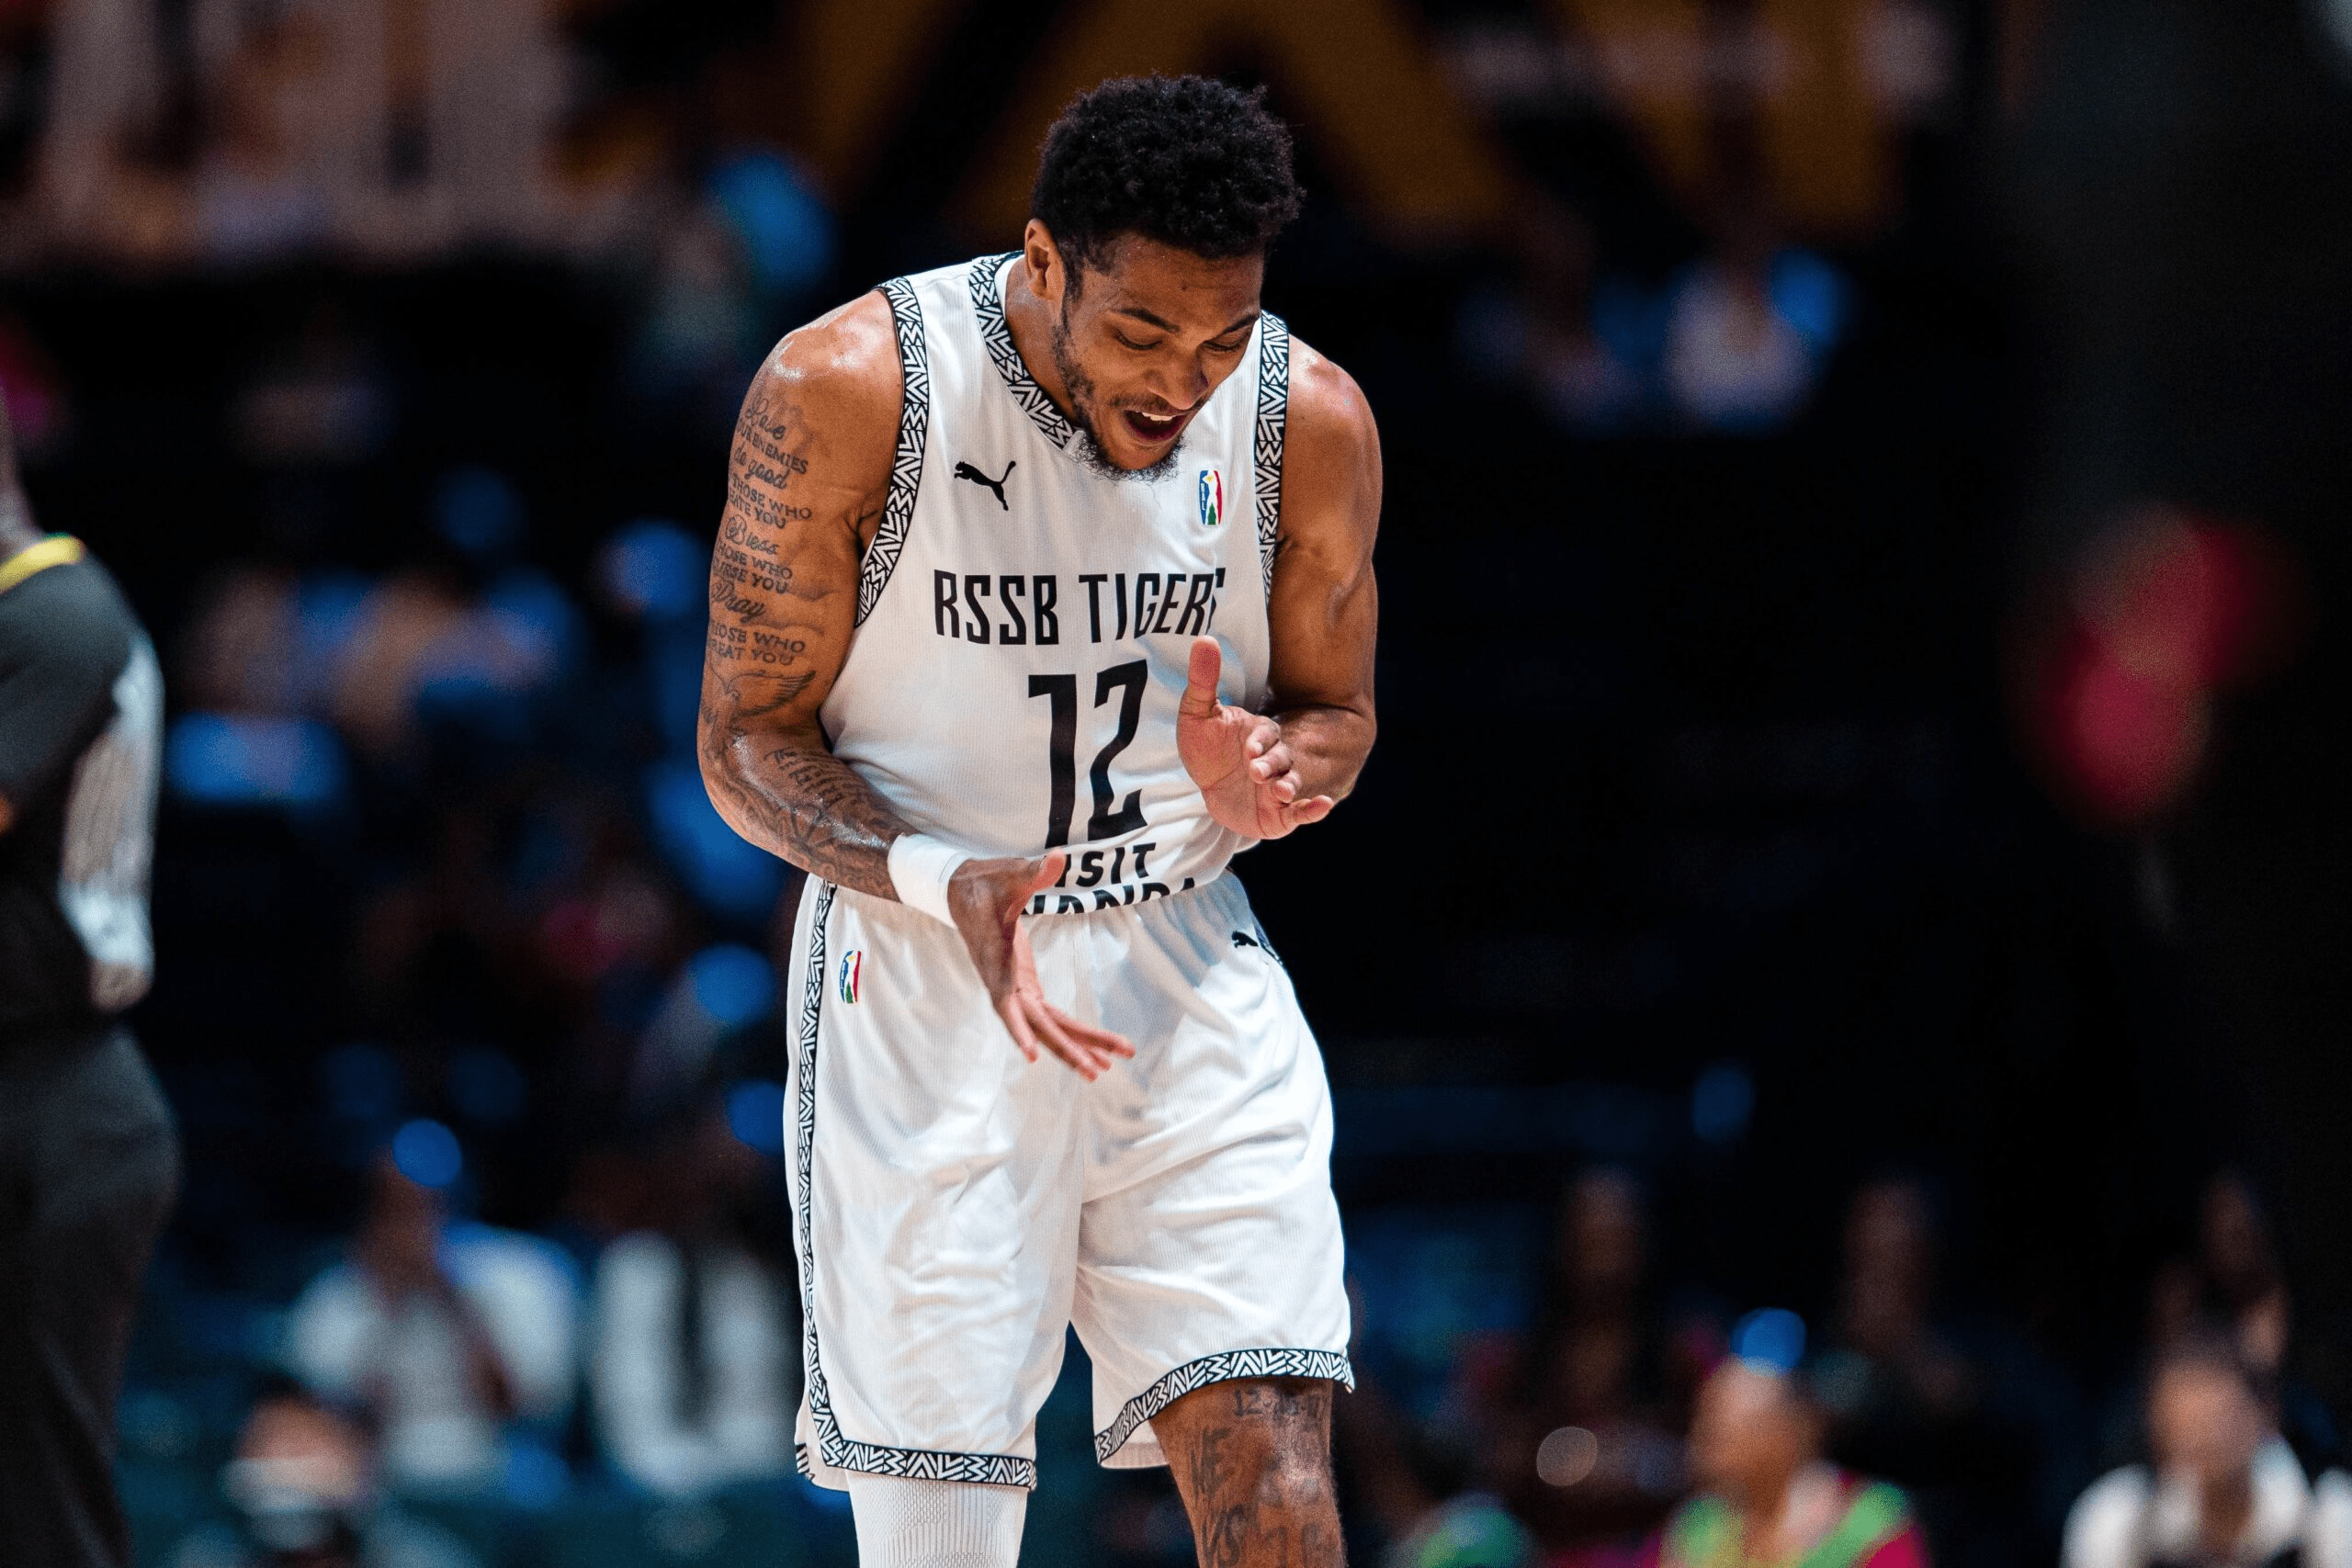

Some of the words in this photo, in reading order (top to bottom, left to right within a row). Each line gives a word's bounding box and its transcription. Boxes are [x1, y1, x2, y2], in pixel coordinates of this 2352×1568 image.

[752, 433, 808, 474] ENEMIES
[744, 460, 790, 490] good
[754, 506, 786, 529] YOU
[769, 498, 812, 519] WHO
[752, 556, 793, 580] WHO
[752, 572, 788, 594] YOU
[934, 569, 1059, 645] RSSB
[753, 631, 806, 653] WHO
[751, 649, 795, 666] YOU
[1028, 659, 1148, 849] 12
[1055, 842, 1156, 887] ISIT
